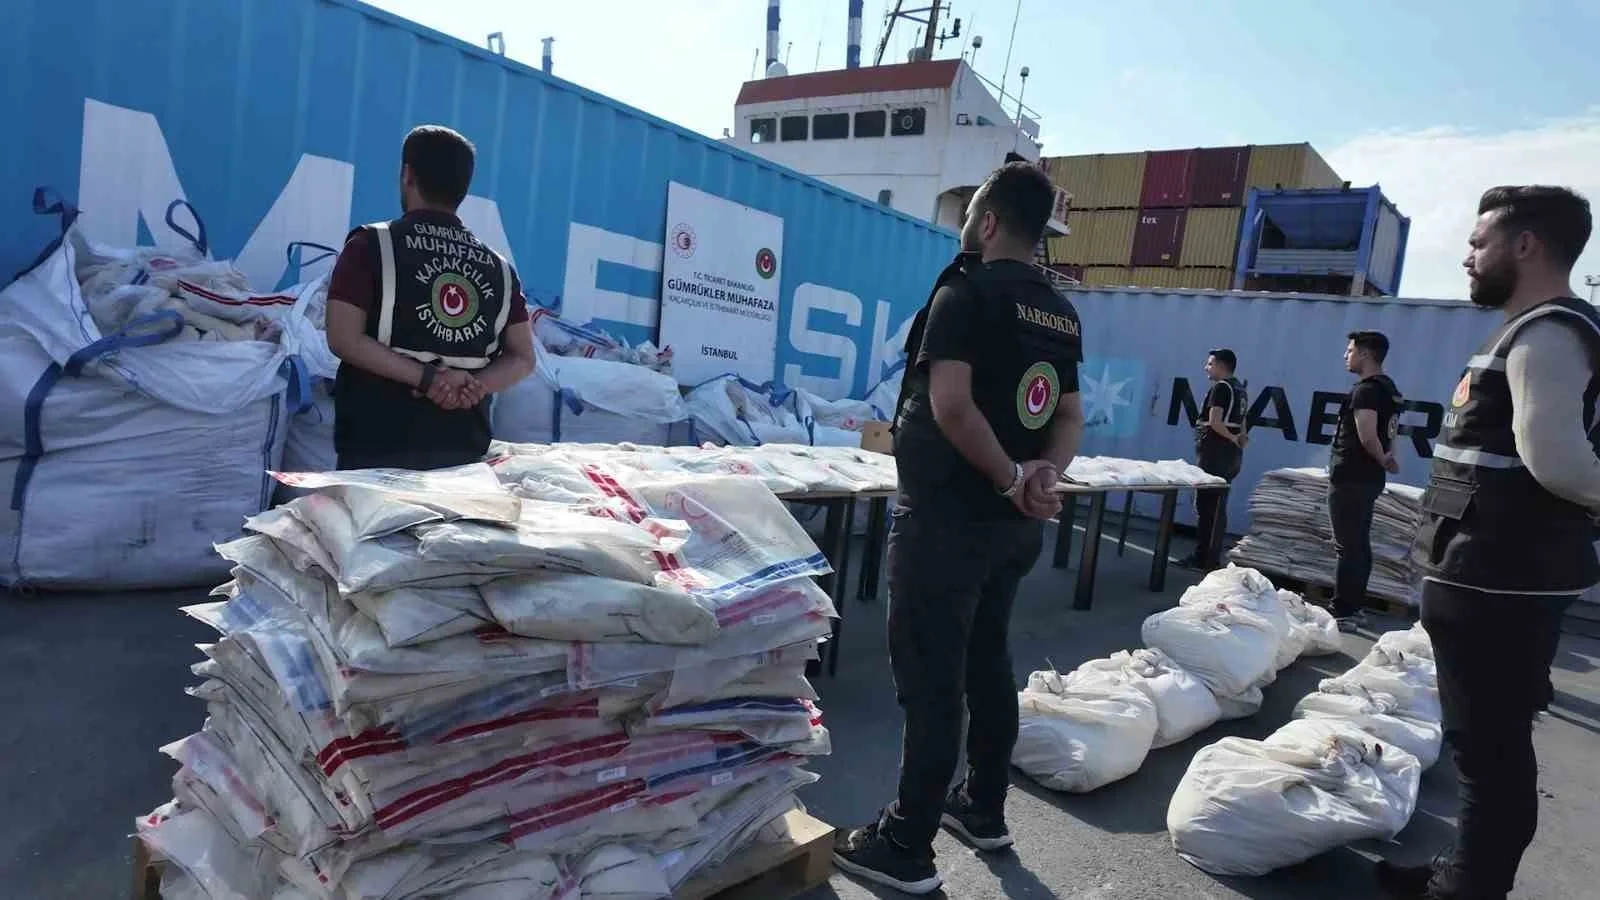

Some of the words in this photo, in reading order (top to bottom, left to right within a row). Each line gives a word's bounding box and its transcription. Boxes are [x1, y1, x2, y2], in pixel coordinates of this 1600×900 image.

[405, 235, 496, 267] MUHAFAZA
[415, 257, 494, 300] KAÇAKÇILIK
[667, 278, 726, 301] GÜMRÜKLER
[726, 291, 775, 311] MUHAFAZA
[415, 303, 488, 343] İSTİHBARAT
[1015, 302, 1080, 337] NARKOKİM
[701, 343, 738, 360] İSTANBUL
